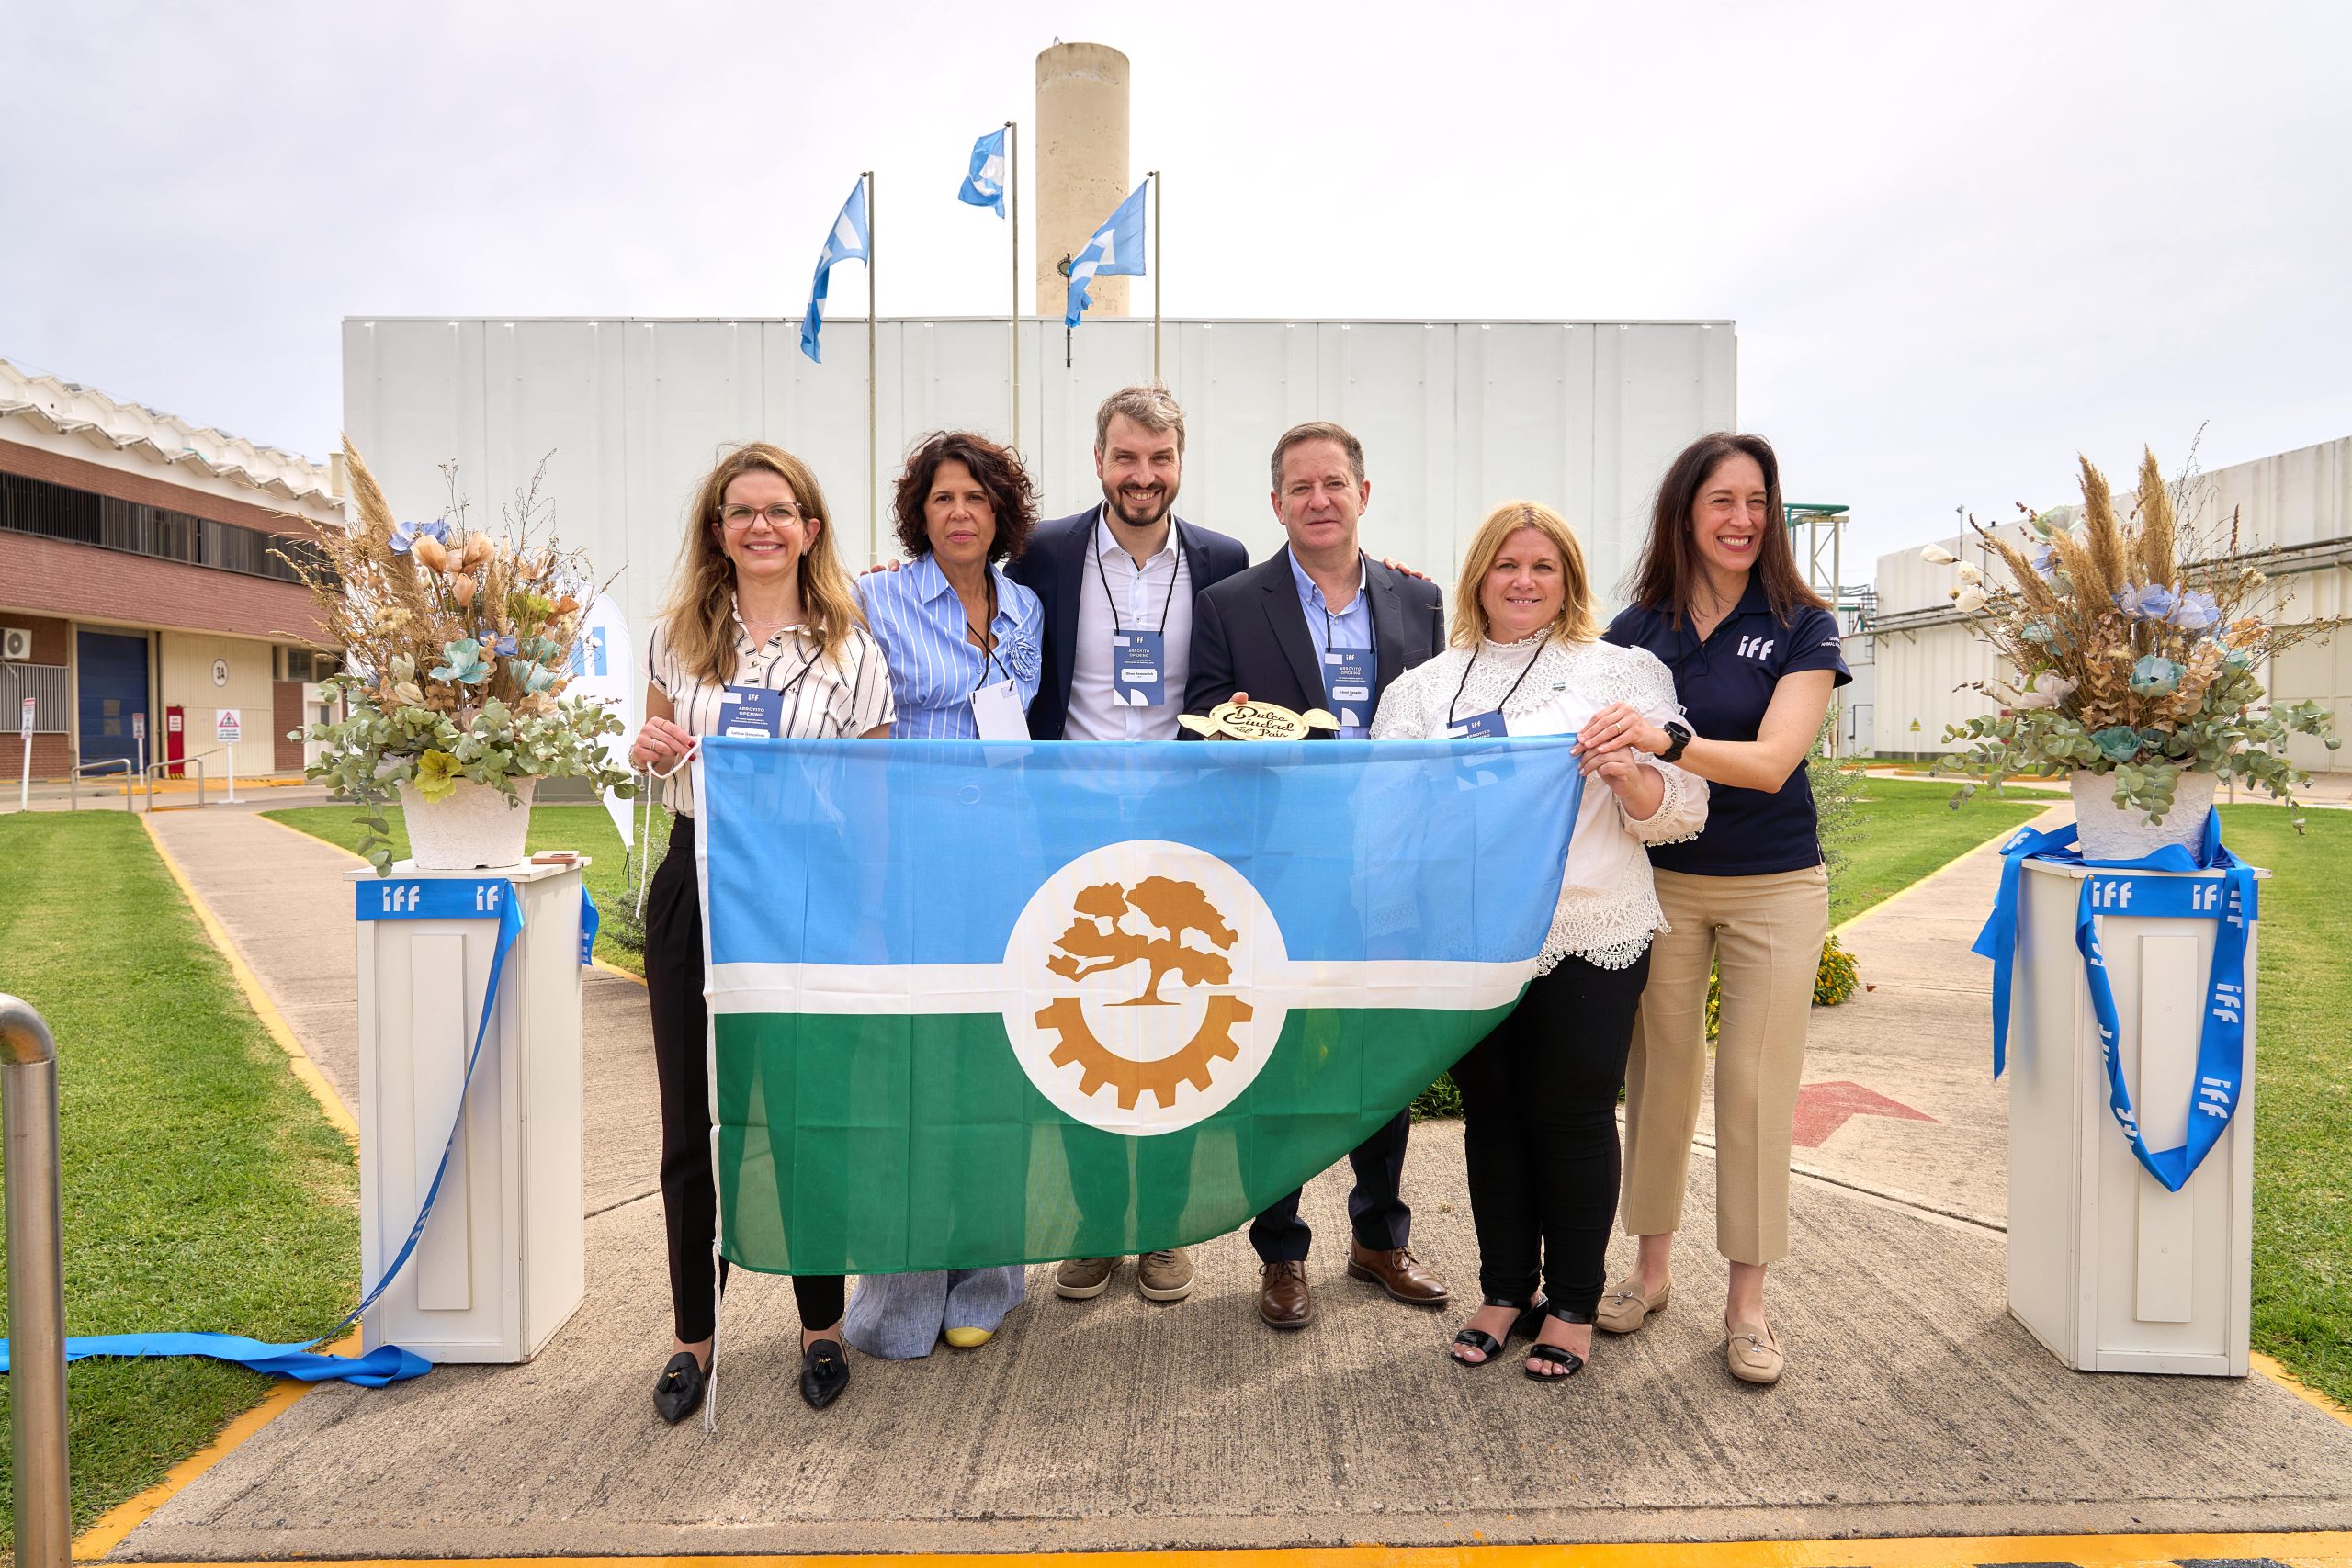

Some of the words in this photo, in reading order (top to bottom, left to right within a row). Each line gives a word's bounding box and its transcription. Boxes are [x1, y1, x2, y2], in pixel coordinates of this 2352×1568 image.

[1737, 635, 1775, 660] iff
[1223, 712, 1295, 732] Ciudad
[1235, 705, 1288, 722] Dulce
[1233, 726, 1253, 734] del
[382, 885, 420, 912] iff
[476, 885, 504, 911] if
[2092, 881, 2132, 908] iff
[2192, 884, 2224, 910] if
[2212, 983, 2242, 1024] iff
[2198, 1077, 2231, 1119] iff
